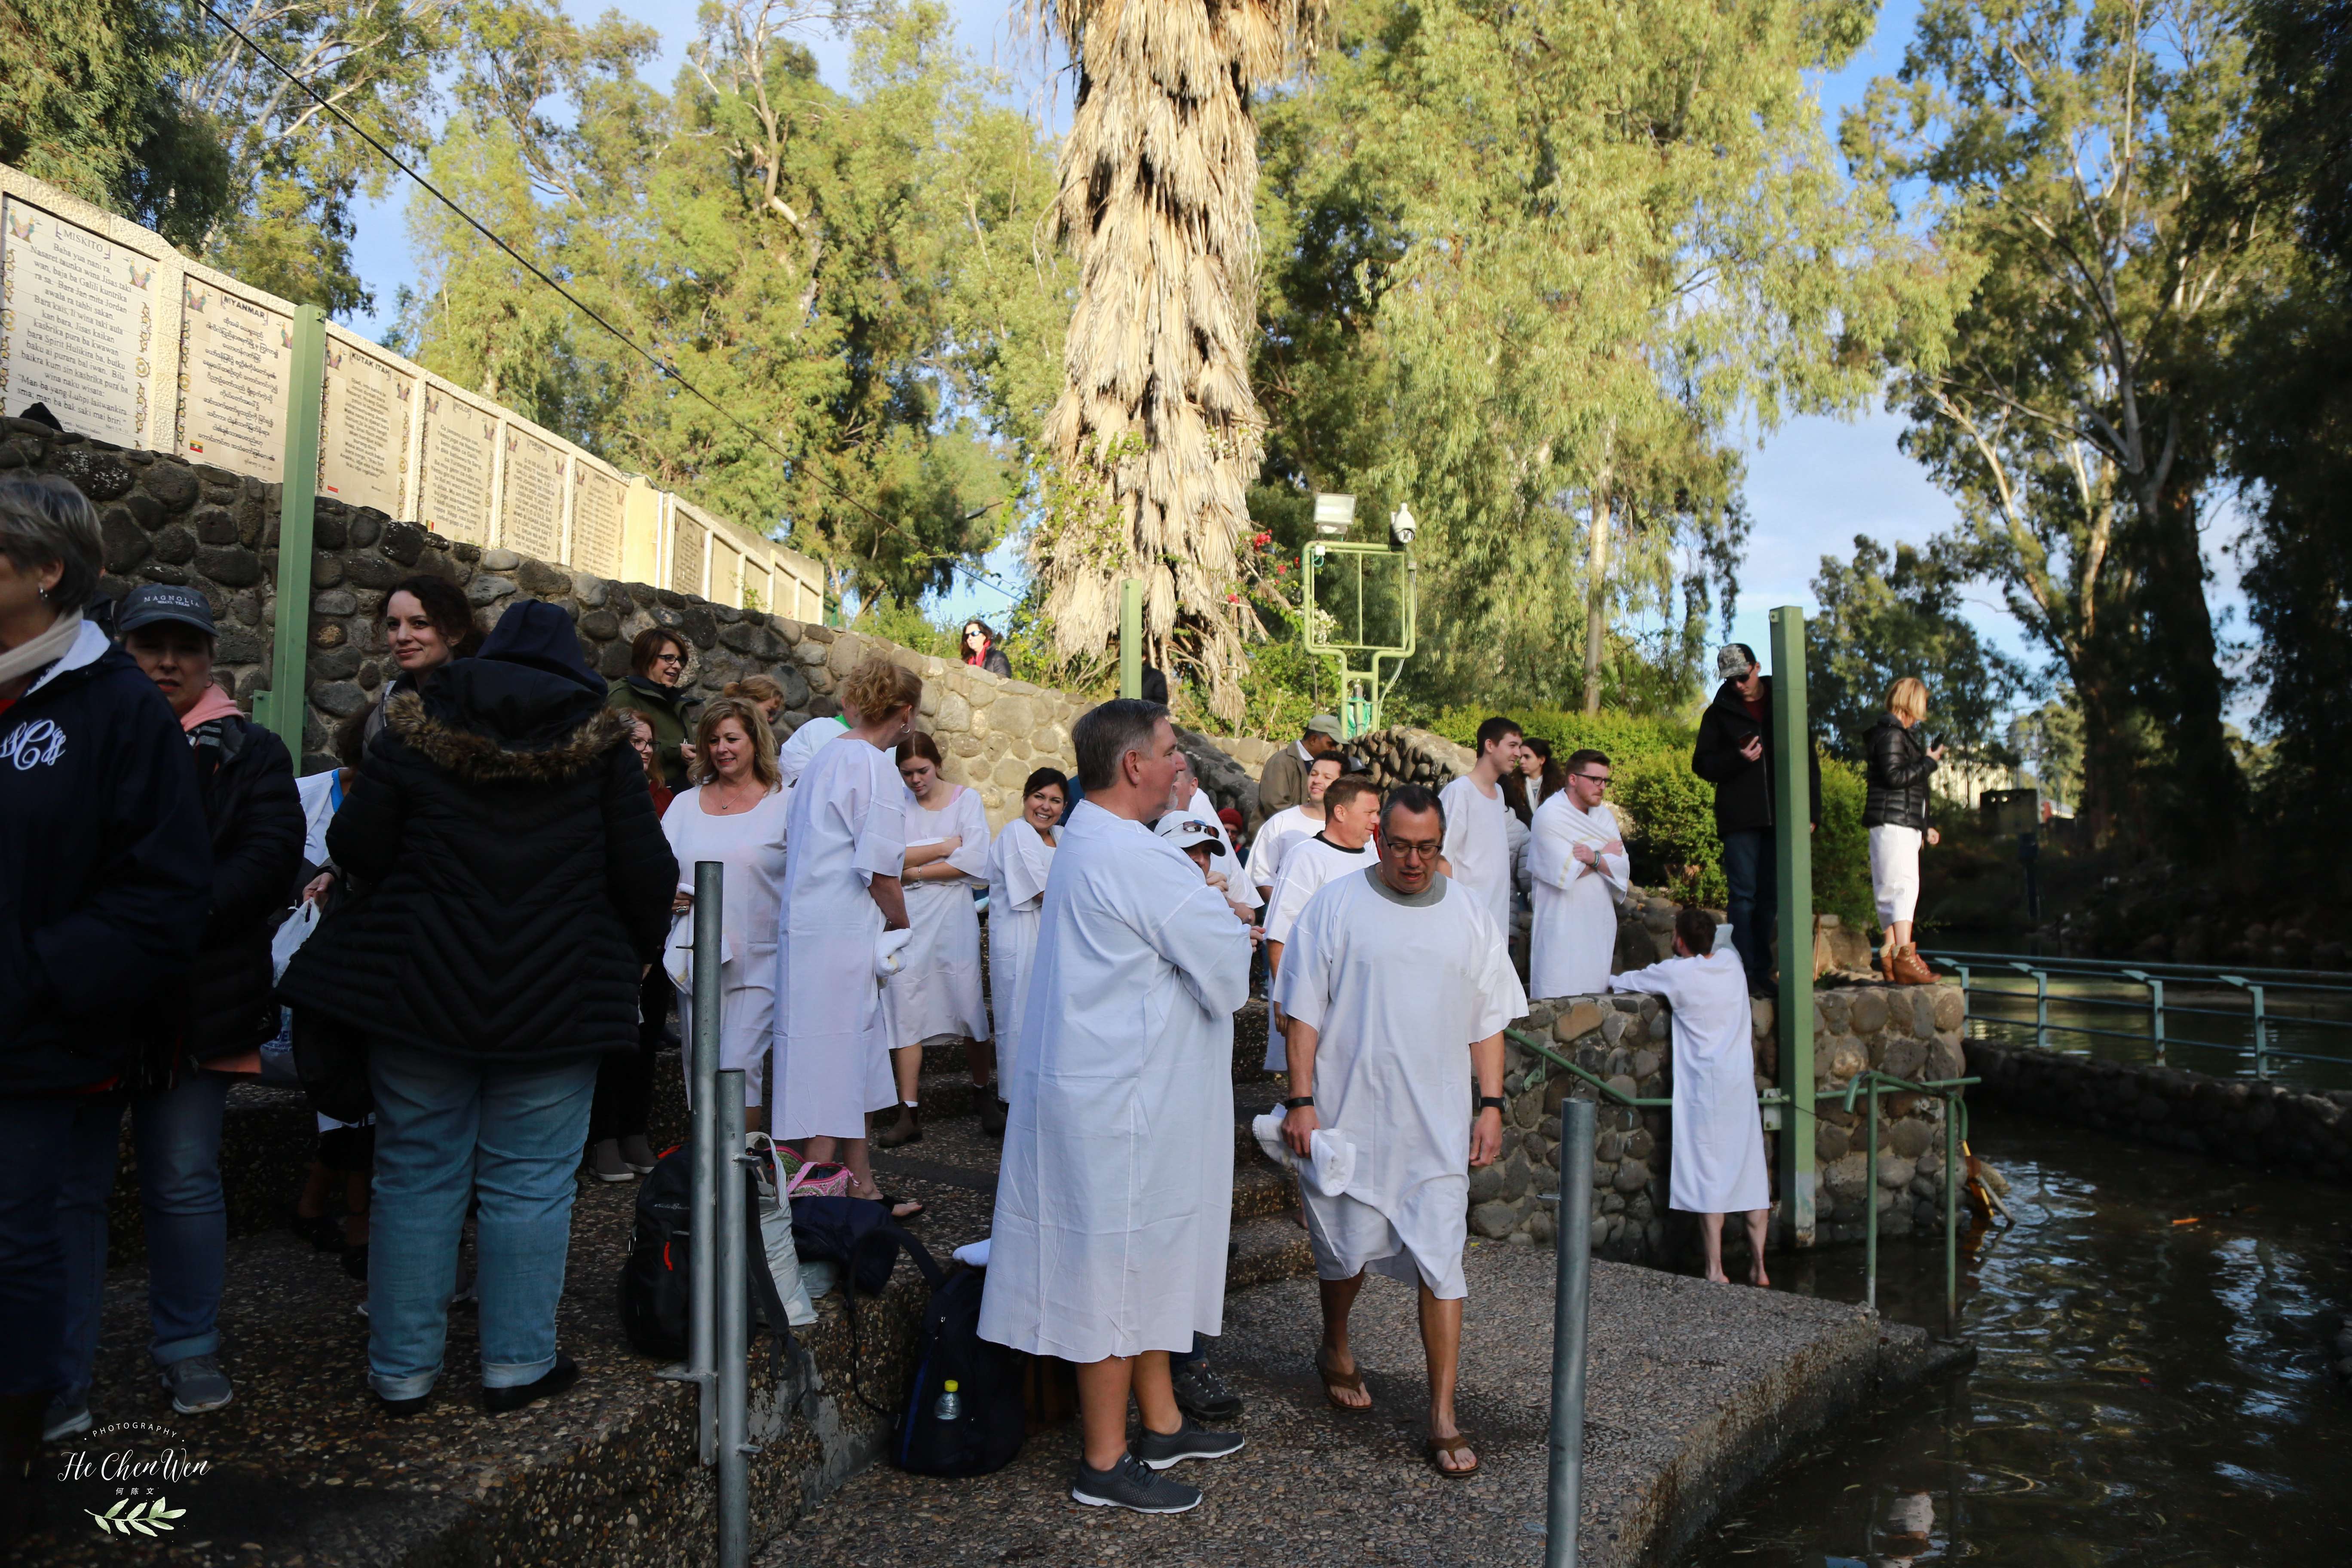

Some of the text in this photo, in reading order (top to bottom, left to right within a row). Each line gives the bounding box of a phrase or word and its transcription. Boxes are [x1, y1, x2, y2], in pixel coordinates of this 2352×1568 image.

[63, 229, 103, 253] MISKITO
[30, 245, 132, 293] Nasaret taunka wina Jisas taki
[53, 242, 111, 276] Baha yua nani ra,
[34, 261, 127, 303] wan, baja ba Galili kuntrika
[44, 277, 53, 285] sa.
[58, 280, 74, 293] Bara
[76, 287, 87, 298] Jan
[89, 294, 104, 305] mita
[105, 299, 127, 314] Jordan
[34, 294, 51, 308] Bara
[53, 301, 69, 316] kais,
[77, 313, 93, 324] wina
[95, 318, 107, 329] taki
[109, 325, 123, 335] aula
[45, 288, 65, 301] awala
[76, 299, 92, 312] tahbi
[94, 308, 114, 320] sakan.
[224, 296, 265, 318] MYANMAR
[34, 318, 119, 356] kasbrika pura ba kwawan
[41, 309, 114, 343] kan bara, Jisas kaikan
[26, 340, 125, 381] baku ai purara bal iwan. Bila
[27, 328, 43, 341] bara
[45, 334, 64, 348] Spirit
[66, 342, 94, 359] Hulikira
[96, 352, 105, 364] ba,
[21, 350, 128, 393] baikra kum sin kasbrika pura ba
[352, 352, 390, 376] KUTAK ITAH
[40, 380, 48, 391] ba
[50, 386, 67, 398] yang
[69, 390, 89, 404] Luhpi
[45, 373, 104, 397] wina naku wisata:
[36, 394, 51, 403] man
[54, 398, 61, 407] ba
[64, 401, 75, 411] bak
[78, 407, 91, 416] saki
[93, 412, 105, 420] mai
[144, 595, 200, 607] MAGNOLIA
